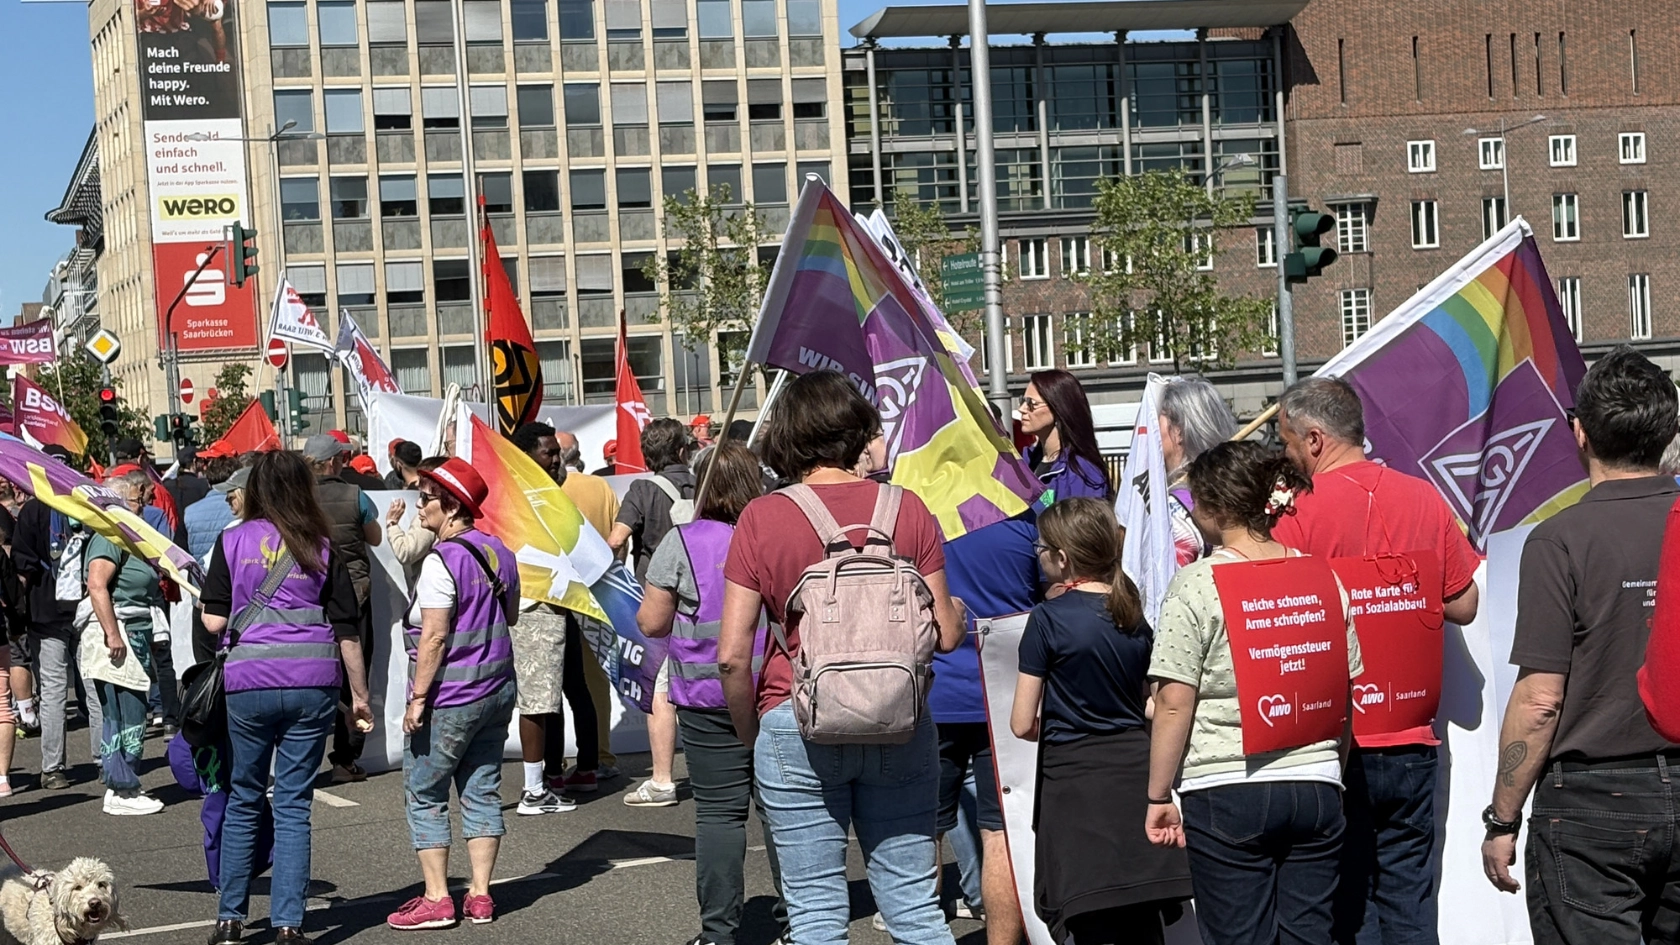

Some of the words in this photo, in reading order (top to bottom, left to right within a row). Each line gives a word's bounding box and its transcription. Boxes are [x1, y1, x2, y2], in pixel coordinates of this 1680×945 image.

[147, 47, 179, 58] Mach
[148, 62, 180, 74] deine
[184, 61, 230, 73] Freunde
[149, 78, 190, 91] happy.
[151, 94, 171, 106] Mit
[174, 94, 210, 106] Wero.
[155, 147, 197, 158] einfach
[156, 163, 178, 174] und
[181, 161, 227, 173] schnell.
[187, 318, 228, 329] Sparkasse
[183, 328, 233, 339] Saarbrücken
[25, 387, 71, 422] BSW
[1351, 588, 1372, 600] Rote
[1375, 585, 1400, 598] Karte
[1647, 588, 1656, 596] für
[1241, 598, 1275, 612] Reiche
[1277, 594, 1322, 608] schonen,
[1351, 605, 1363, 615] en
[1366, 597, 1426, 614] Sozialabbau!
[1246, 618, 1271, 630] Arme
[1274, 609, 1326, 627] schröpfen?
[1248, 641, 1331, 660] Vermögenssteuer
[1279, 658, 1305, 676] jetzt!
[1361, 692, 1384, 705] AWO
[1396, 688, 1426, 700] Saarland
[1268, 703, 1291, 717] AWO
[1302, 699, 1332, 711] Saarland
